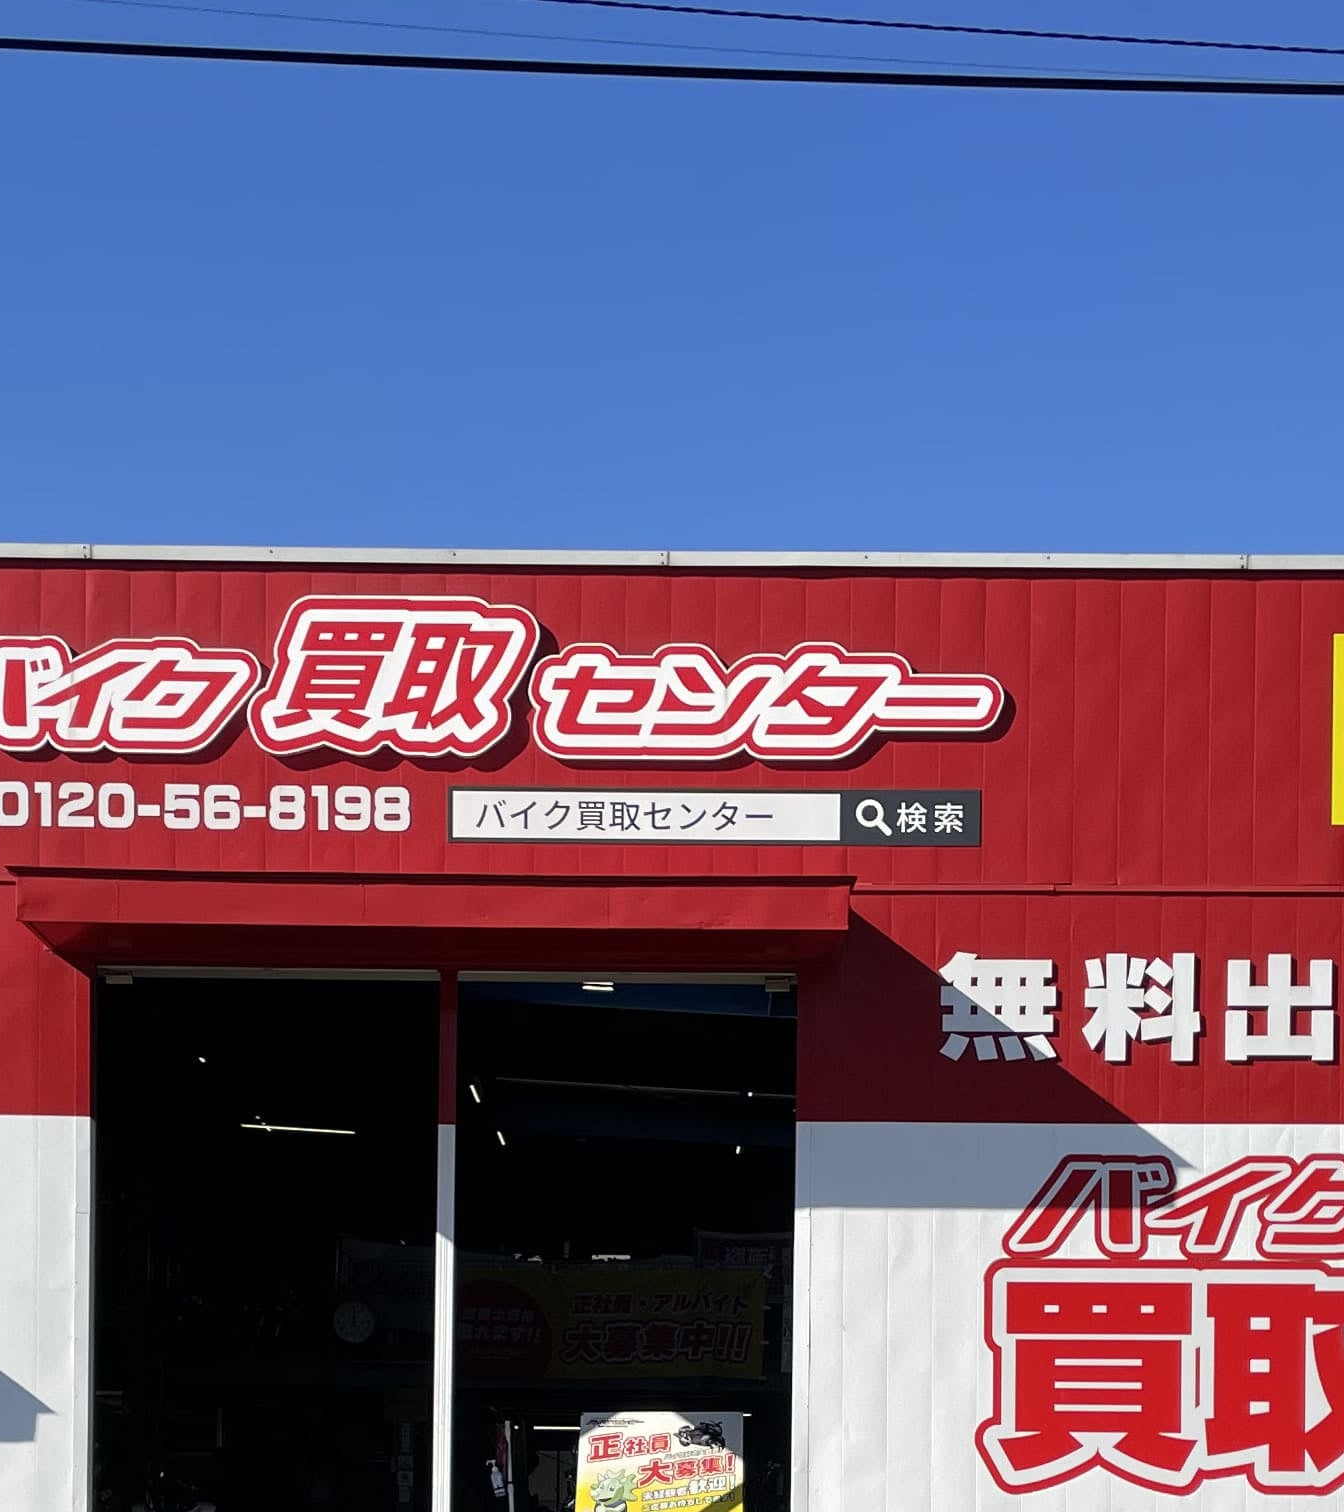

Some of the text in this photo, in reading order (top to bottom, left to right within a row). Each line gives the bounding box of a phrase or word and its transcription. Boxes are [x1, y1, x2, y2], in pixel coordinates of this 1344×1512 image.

[474, 798, 965, 835] バイク買取センター 検索
[587, 1432, 672, 1463] 正社員
